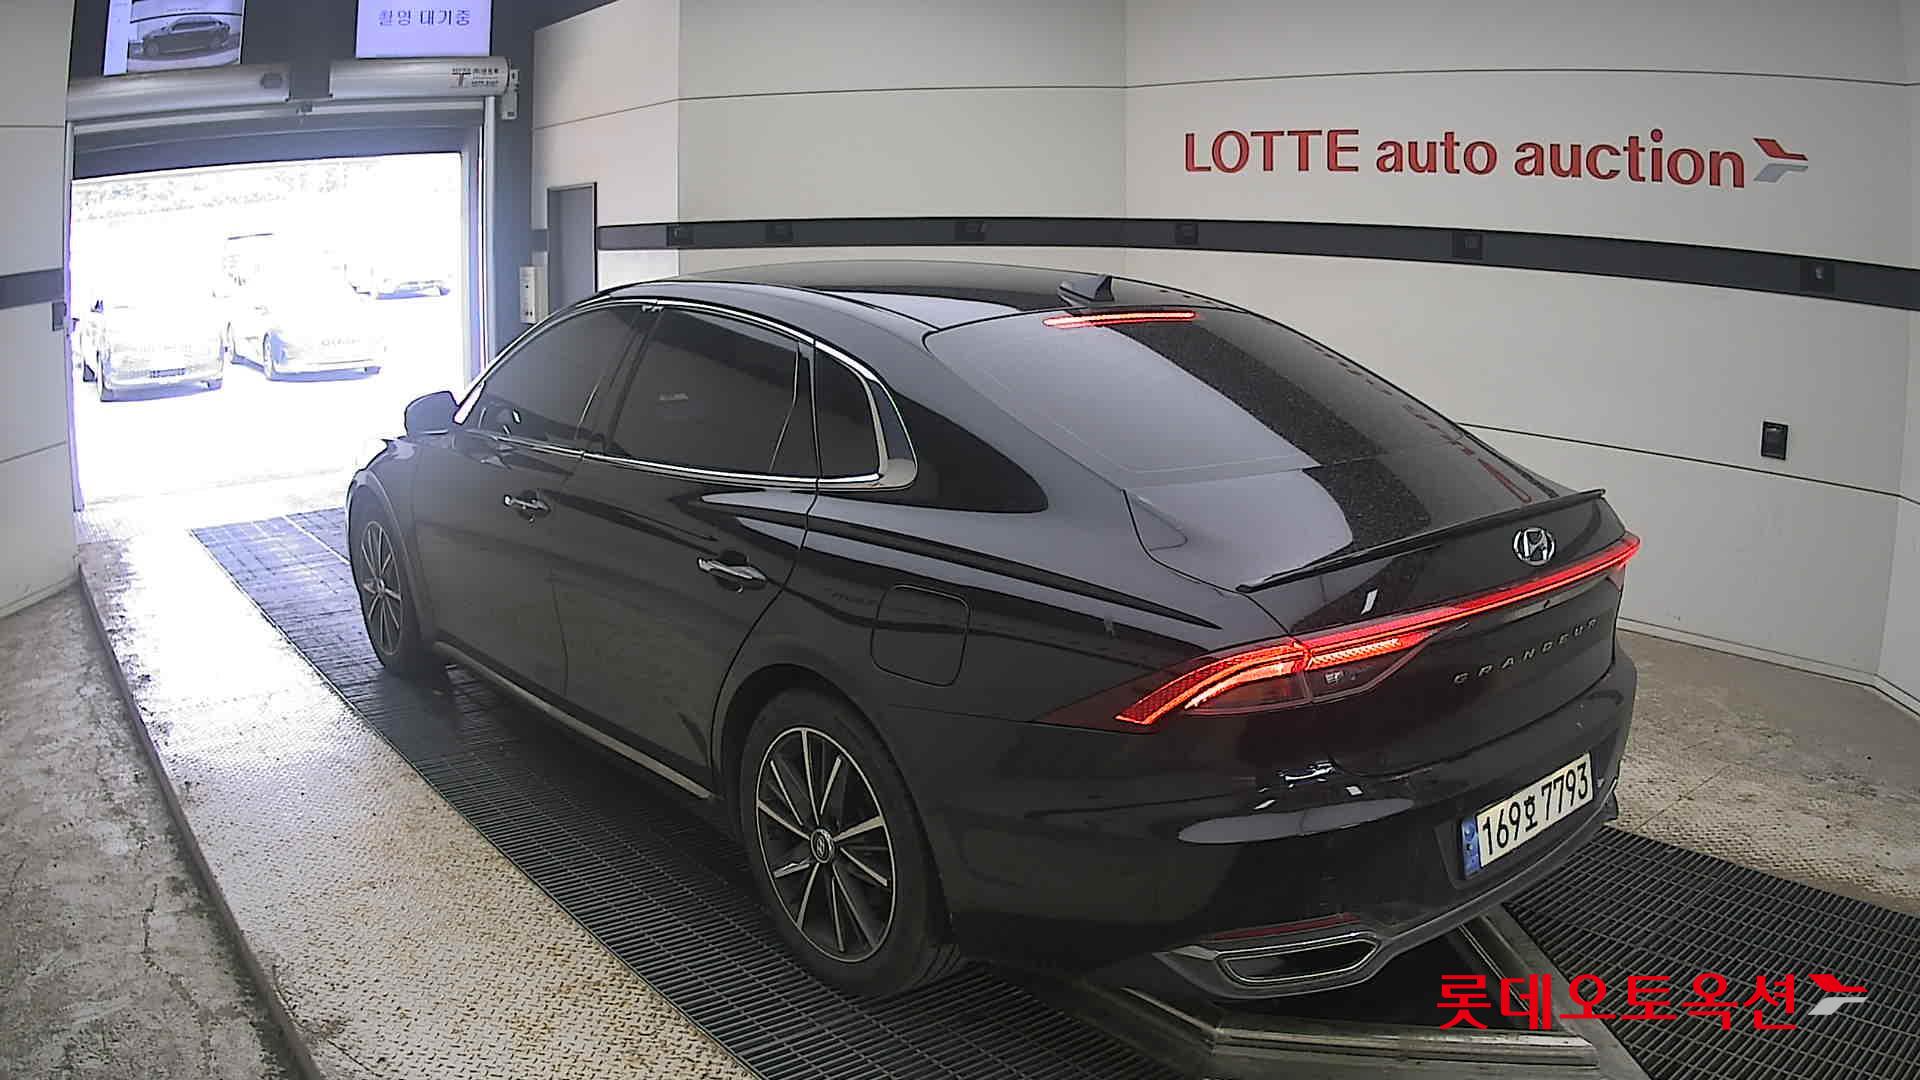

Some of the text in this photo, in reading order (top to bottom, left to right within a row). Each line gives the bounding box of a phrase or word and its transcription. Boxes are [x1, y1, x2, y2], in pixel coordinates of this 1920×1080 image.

[420, 9, 471, 27] 대기중
[1184, 128, 1745, 189] LOTTE auto auction
[1453, 617, 1599, 684] GRANDEUR
